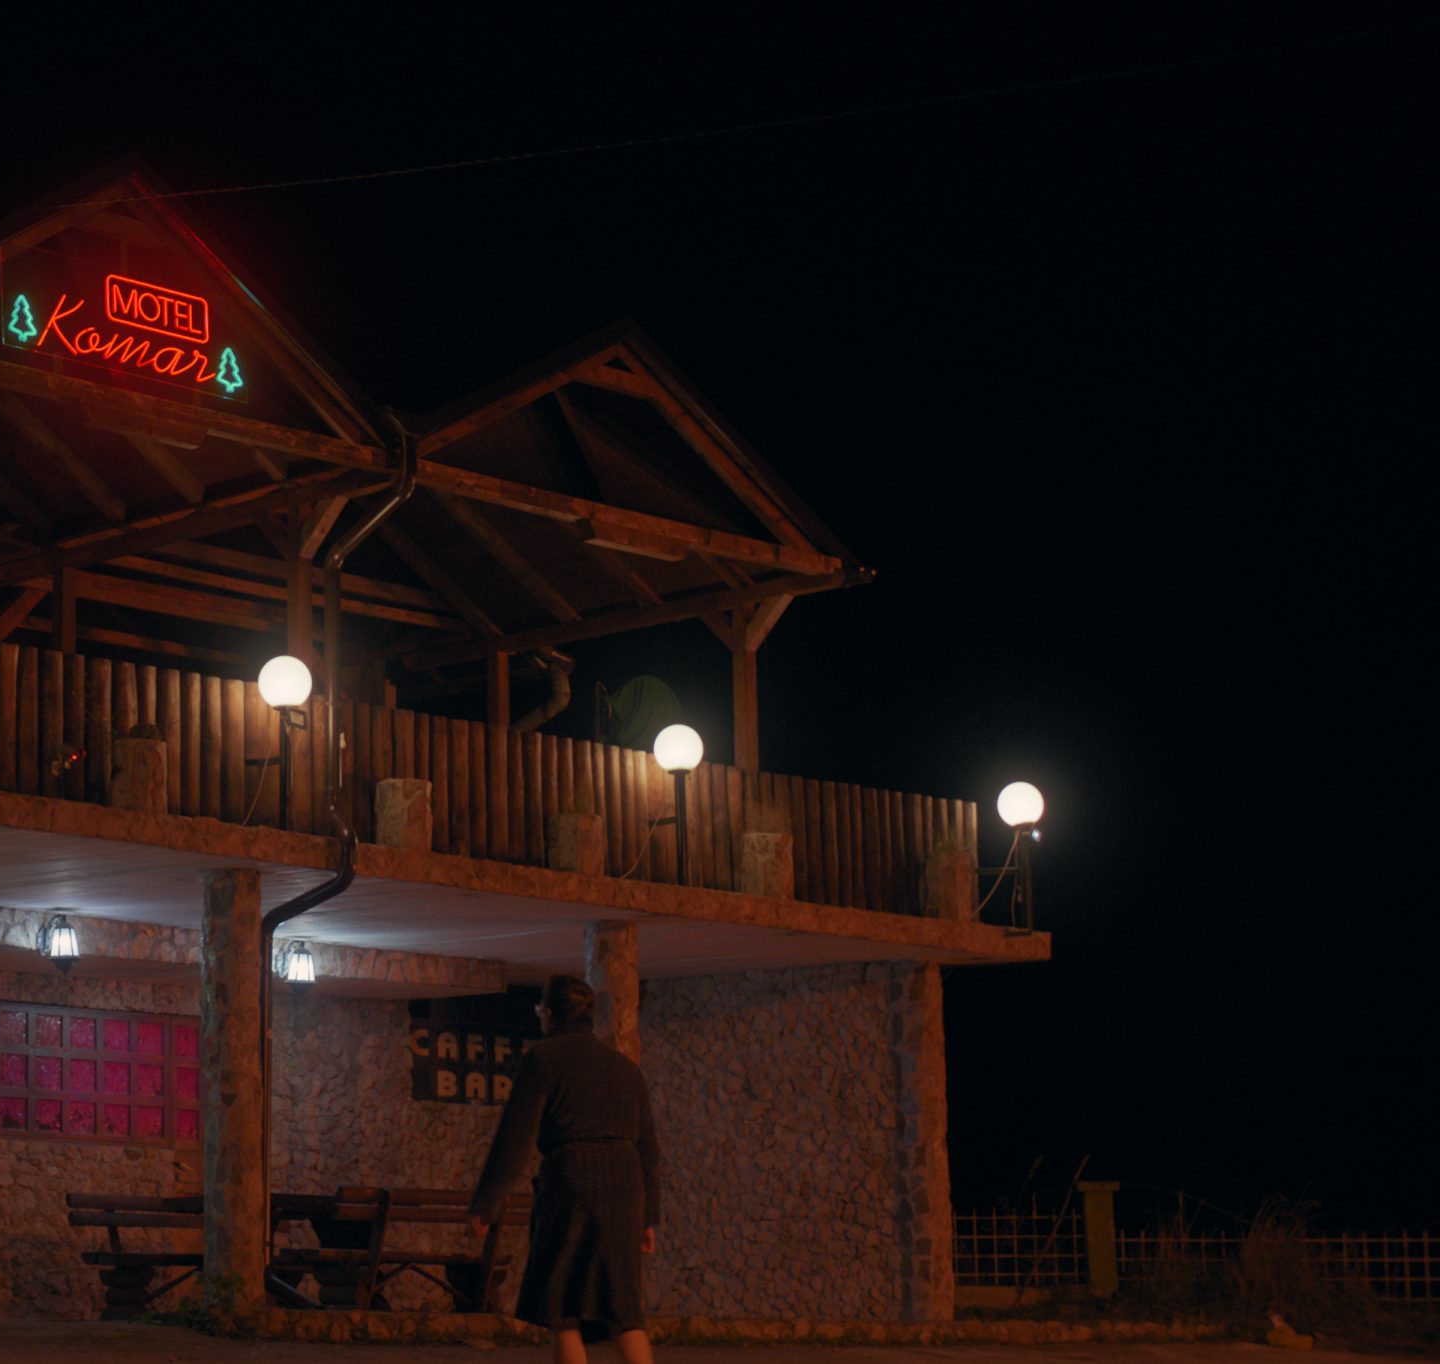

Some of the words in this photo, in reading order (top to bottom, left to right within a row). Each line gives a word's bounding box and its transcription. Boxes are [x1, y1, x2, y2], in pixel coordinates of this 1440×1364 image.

[111, 283, 203, 335] MOTEL
[35, 293, 216, 383] Komar
[409, 1028, 530, 1063] CAFF
[436, 1068, 513, 1104] BAR
